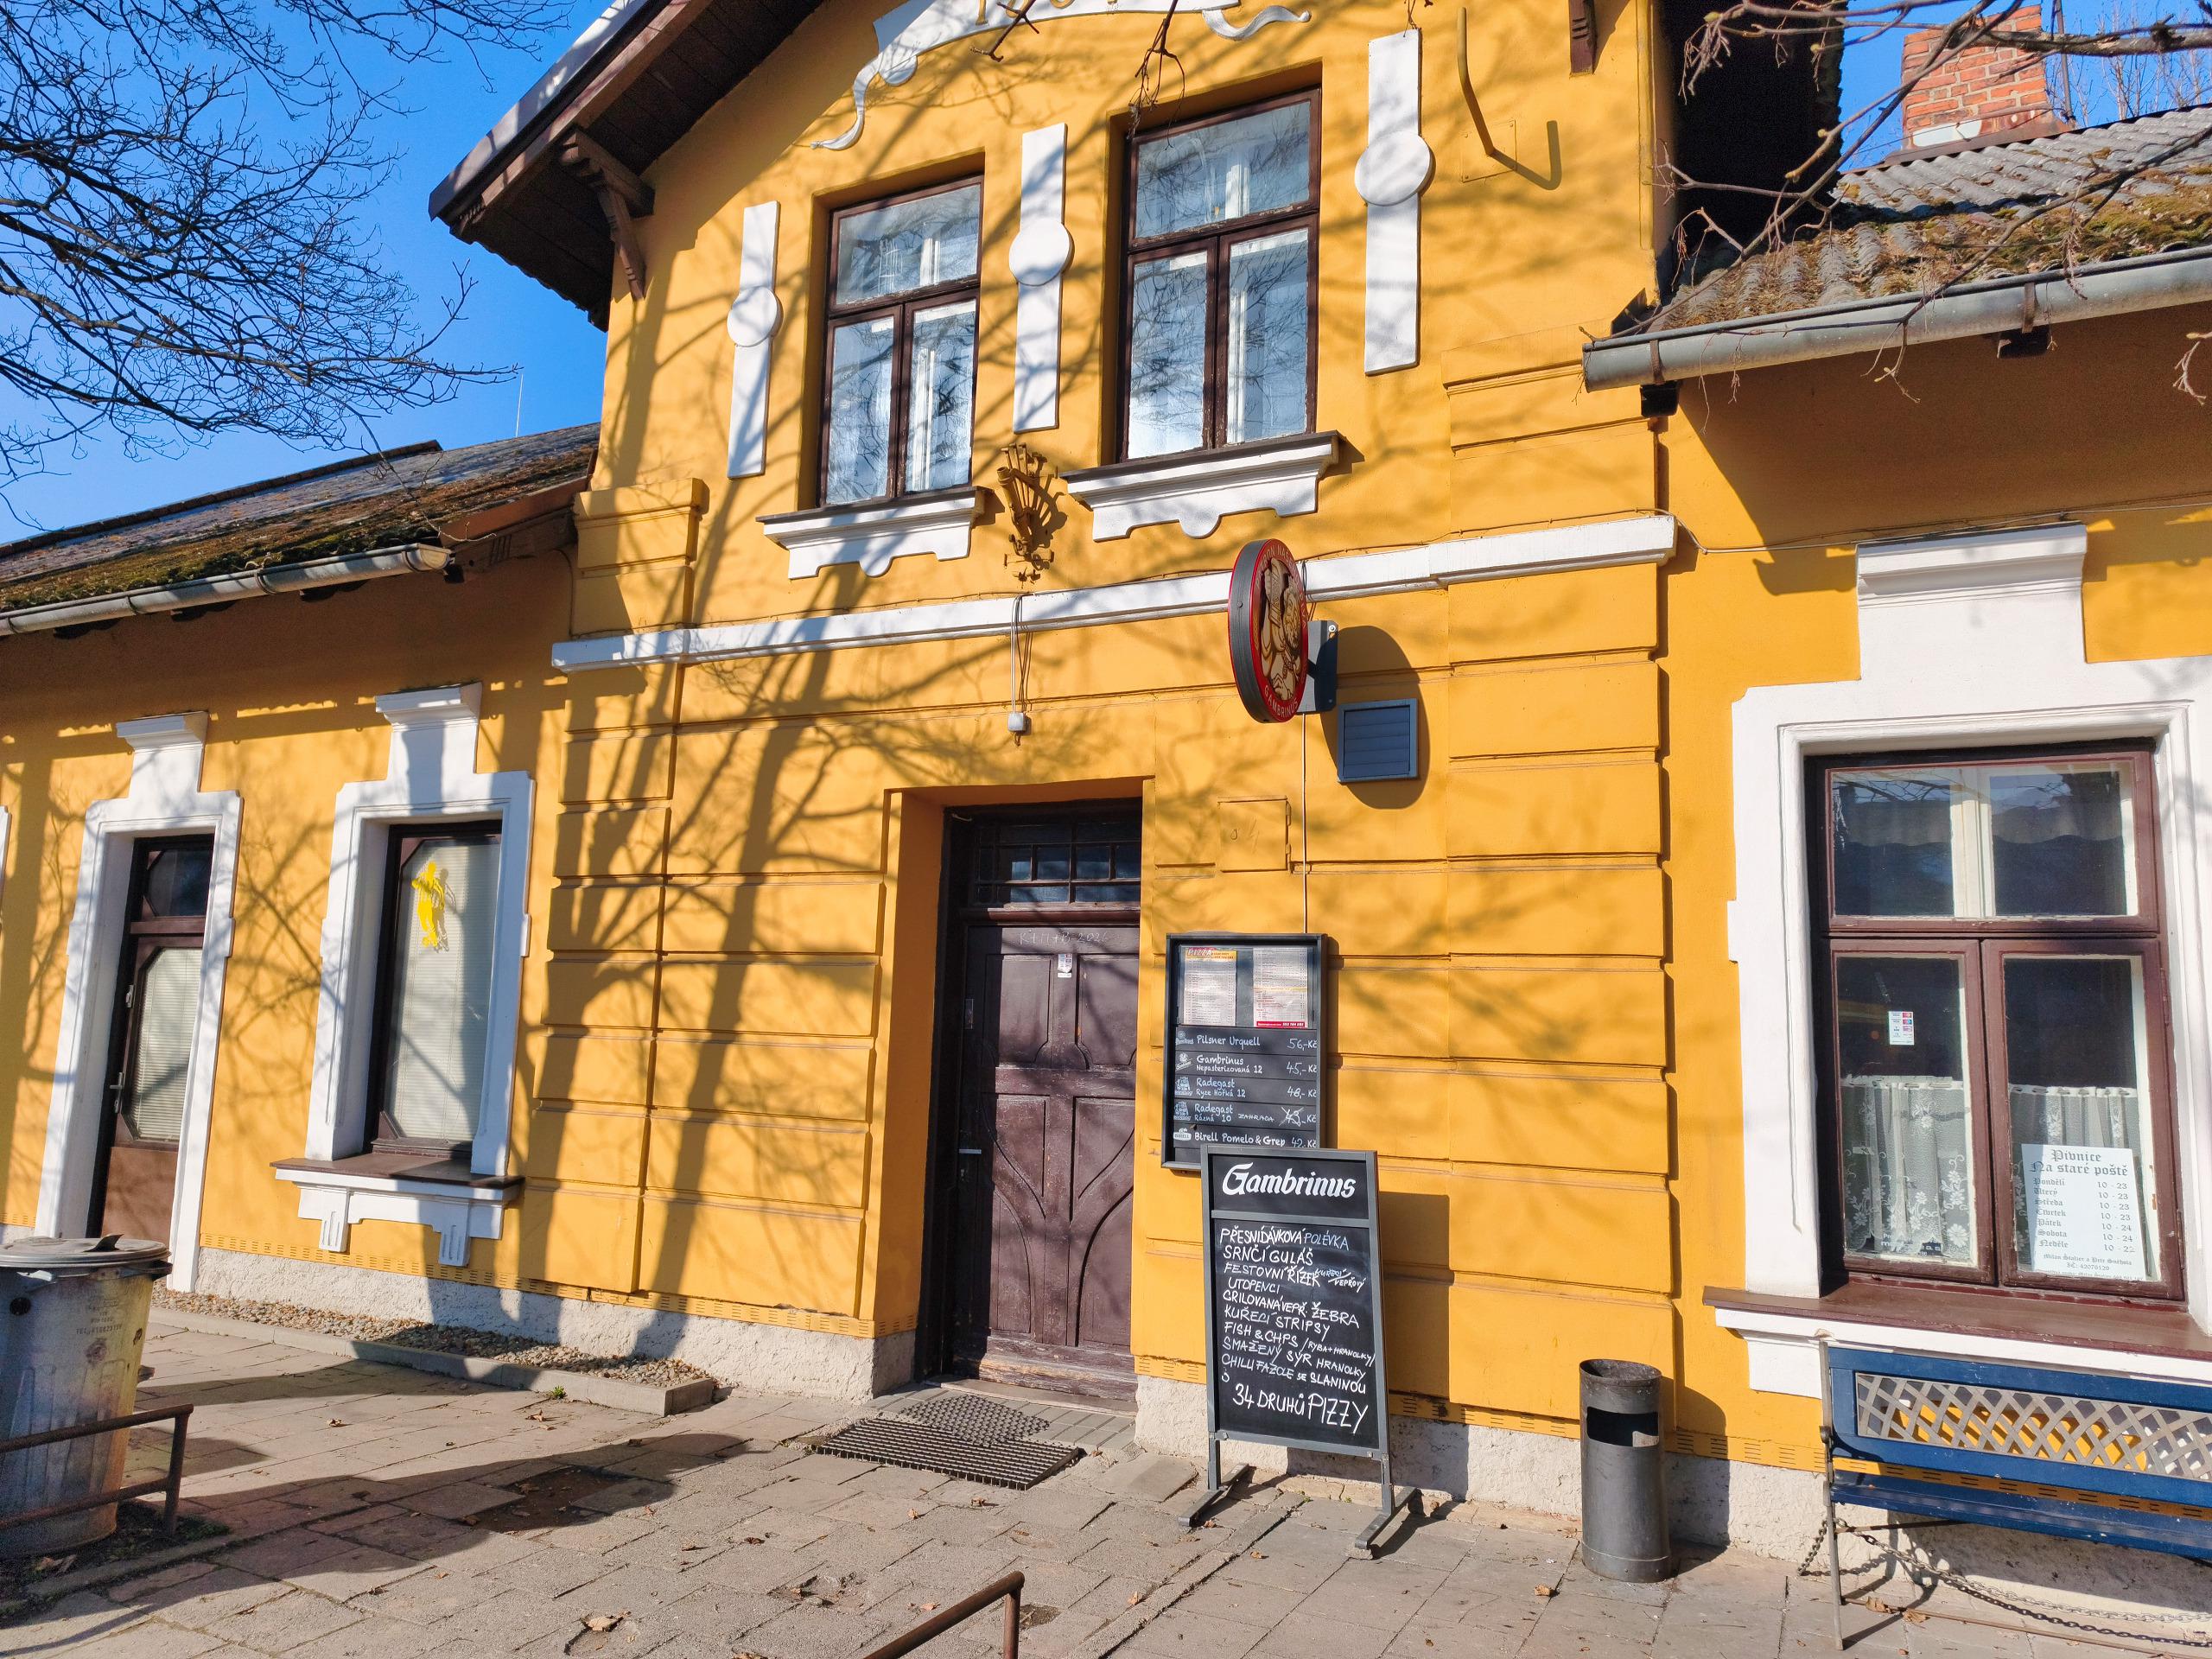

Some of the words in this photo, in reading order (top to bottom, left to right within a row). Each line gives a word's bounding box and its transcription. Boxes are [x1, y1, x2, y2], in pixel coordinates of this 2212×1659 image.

[1264, 685, 1298, 718] GAMBRINUS
[1196, 1034, 1226, 1045] Pilsner
[1229, 1036, 1261, 1050] Urquell
[1307, 1039, 1317, 1048] Kč
[1196, 1053, 1244, 1065] Gambrinus
[1196, 1065, 1250, 1075] Nepasterizovaná
[1196, 1077, 1236, 1090] Radegast
[1196, 1089, 1211, 1098] Ryze
[1214, 1088, 1233, 1096] Hořká
[1236, 1089, 1245, 1097] 12
[1194, 1102, 1233, 1116] Radegast
[1194, 1113, 1214, 1122] Rázná
[1194, 1132, 1218, 1141] Birell
[1222, 1133, 1254, 1143] Pomelo
[1255, 1135, 1262, 1145] &
[1262, 1135, 1286, 1147] Grep
[2051, 1149, 2101, 1162] Pivnice
[2030, 1160, 2052, 1173] Na
[2057, 1162, 2090, 1174] staré
[2094, 1164, 2128, 1177] poště
[1222, 1161, 1357, 1198] Gambrinus
[1303, 1230, 1350, 1251] POLÉVKA
[2038, 1228, 2067, 1237] Sobota
[1223, 1243, 1271, 1262] SRNČÍ
[1268, 1247, 1313, 1266] GULÁŠ
[1224, 1262, 1288, 1280] FESTOVNÍ
[1287, 1264, 1320, 1287] ŘÍZEK
[1228, 1276, 1281, 1294] UTOPENCI
[1223, 1289, 1284, 1312] GRILOVANÁ
[1311, 1301, 1360, 1329] ŽEBRA
[1224, 1304, 1278, 1325] KUŘECÍ
[1275, 1316, 1331, 1342] STRIPSY
[1224, 1321, 1252, 1336] FISH
[1254, 1329, 1264, 1341] &
[1222, 1335, 1282, 1364] SMAŽENÝ
[1286, 1351, 1313, 1367] SÝR
[1316, 1357, 1366, 1384] HRANOLKY
[1296, 1372, 1307, 1382] SE
[1310, 1371, 1366, 1395] SLANINOU
[1232, 1382, 1255, 1409] 34
[1256, 1389, 1306, 1416] DRUHŮ
[1307, 1392, 1369, 1434] PIZZY
